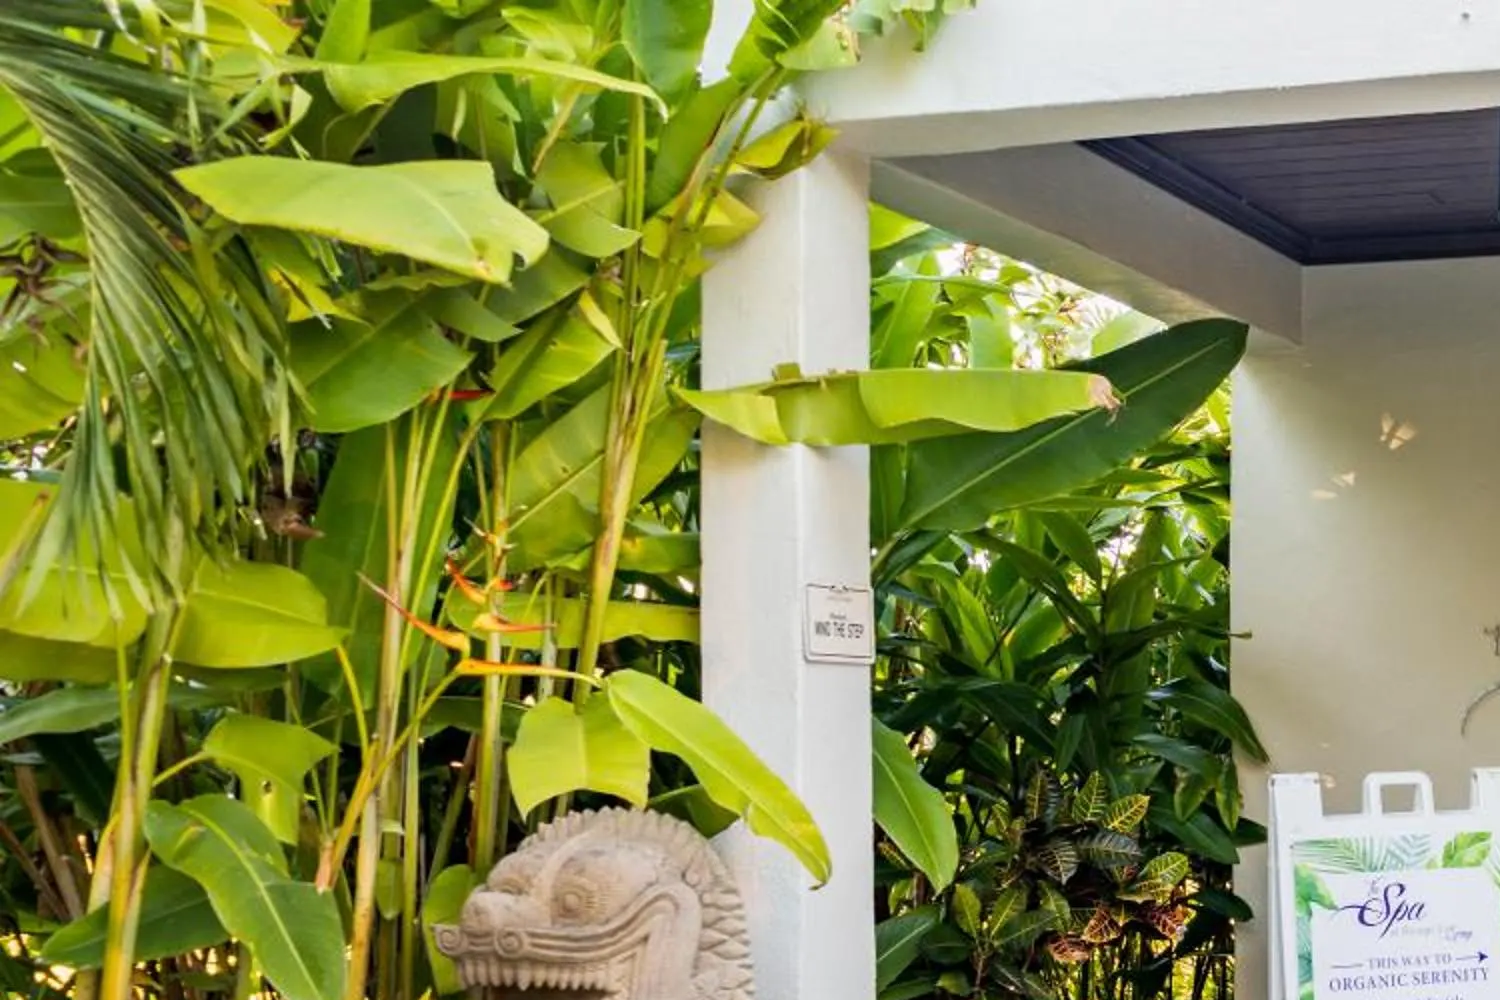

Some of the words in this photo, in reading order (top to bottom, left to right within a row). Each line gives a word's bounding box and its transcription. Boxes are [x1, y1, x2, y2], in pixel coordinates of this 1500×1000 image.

[1330, 882, 1427, 943] Spa
[1368, 957, 1399, 970] THIS
[1400, 955, 1430, 968] WAY
[1434, 953, 1452, 966] TO
[1328, 973, 1409, 992] ORGANIC
[1411, 967, 1490, 986] SERENITY
